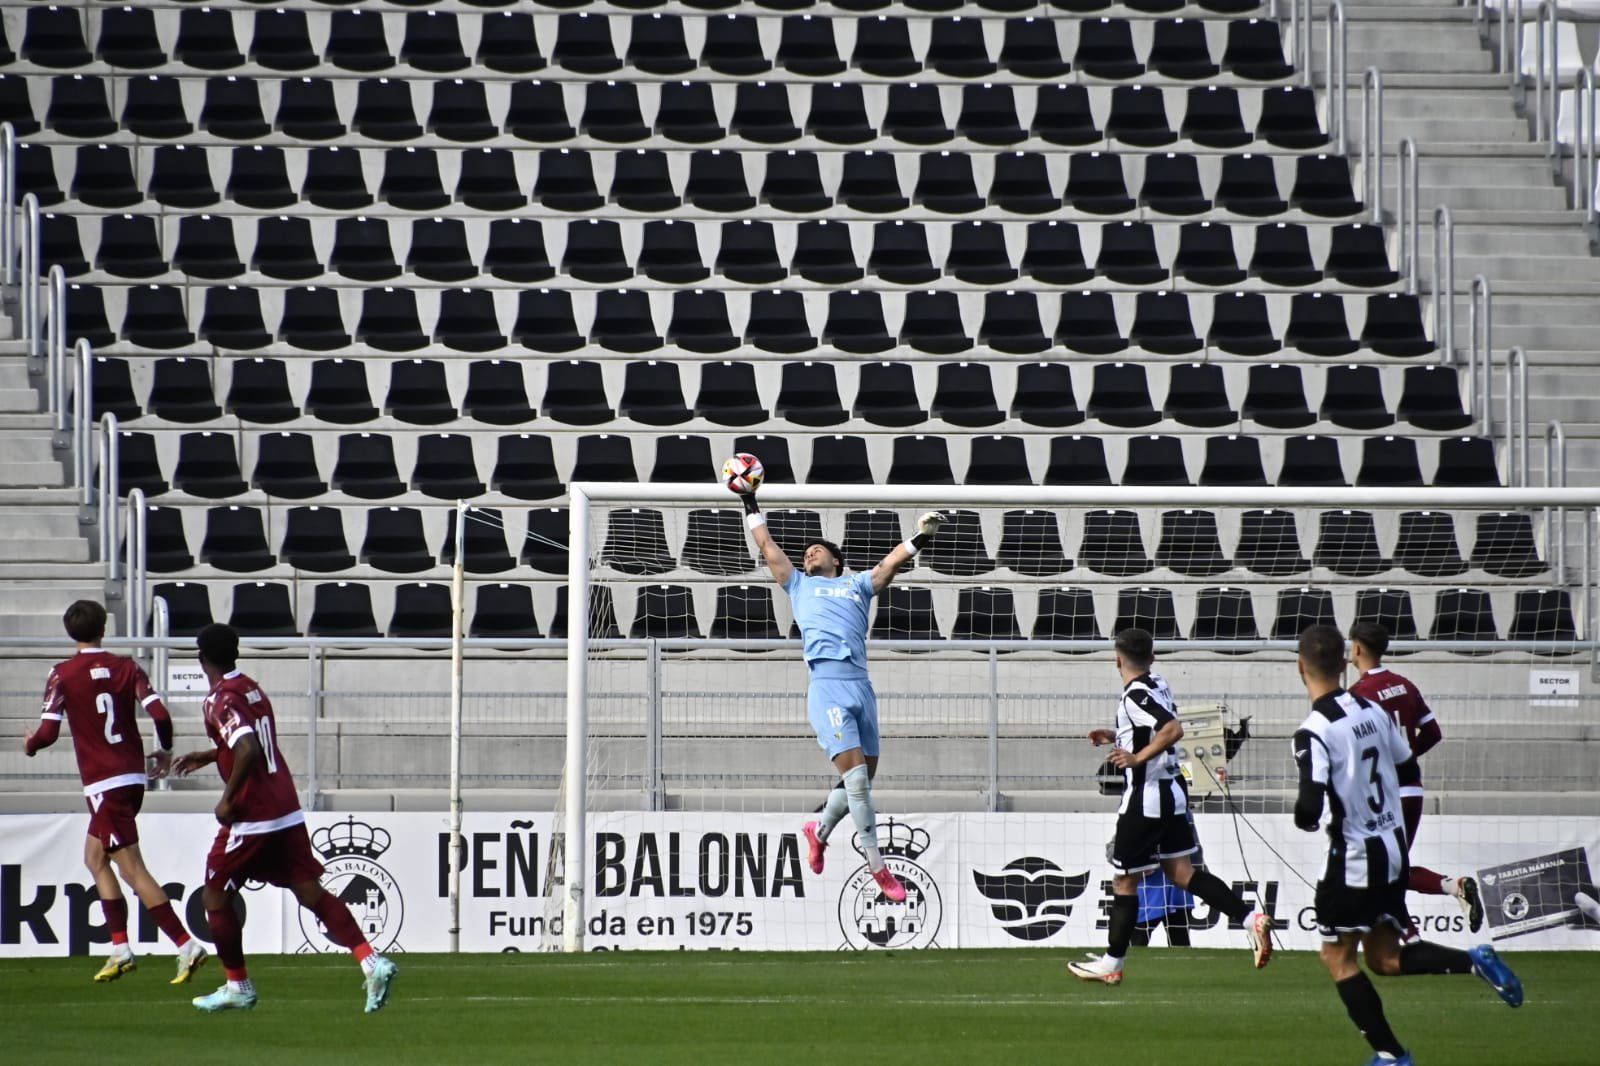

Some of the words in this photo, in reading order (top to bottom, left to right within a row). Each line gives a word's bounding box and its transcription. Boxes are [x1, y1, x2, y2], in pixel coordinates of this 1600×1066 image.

[172, 673, 204, 681] SECTOR
[1539, 677, 1570, 685] SECTOR
[95, 692, 122, 745] 2
[826, 706, 843, 728] 13
[1351, 719, 1378, 741] NANI
[1360, 745, 1385, 815] 3
[344, 862, 392, 890] BALONA
[594, 831, 805, 898] BALONA
[1528, 858, 1565, 873] NARANJA
[489, 909, 626, 937] Fundda
[636, 914, 675, 936] en
[685, 911, 754, 937] 1975
